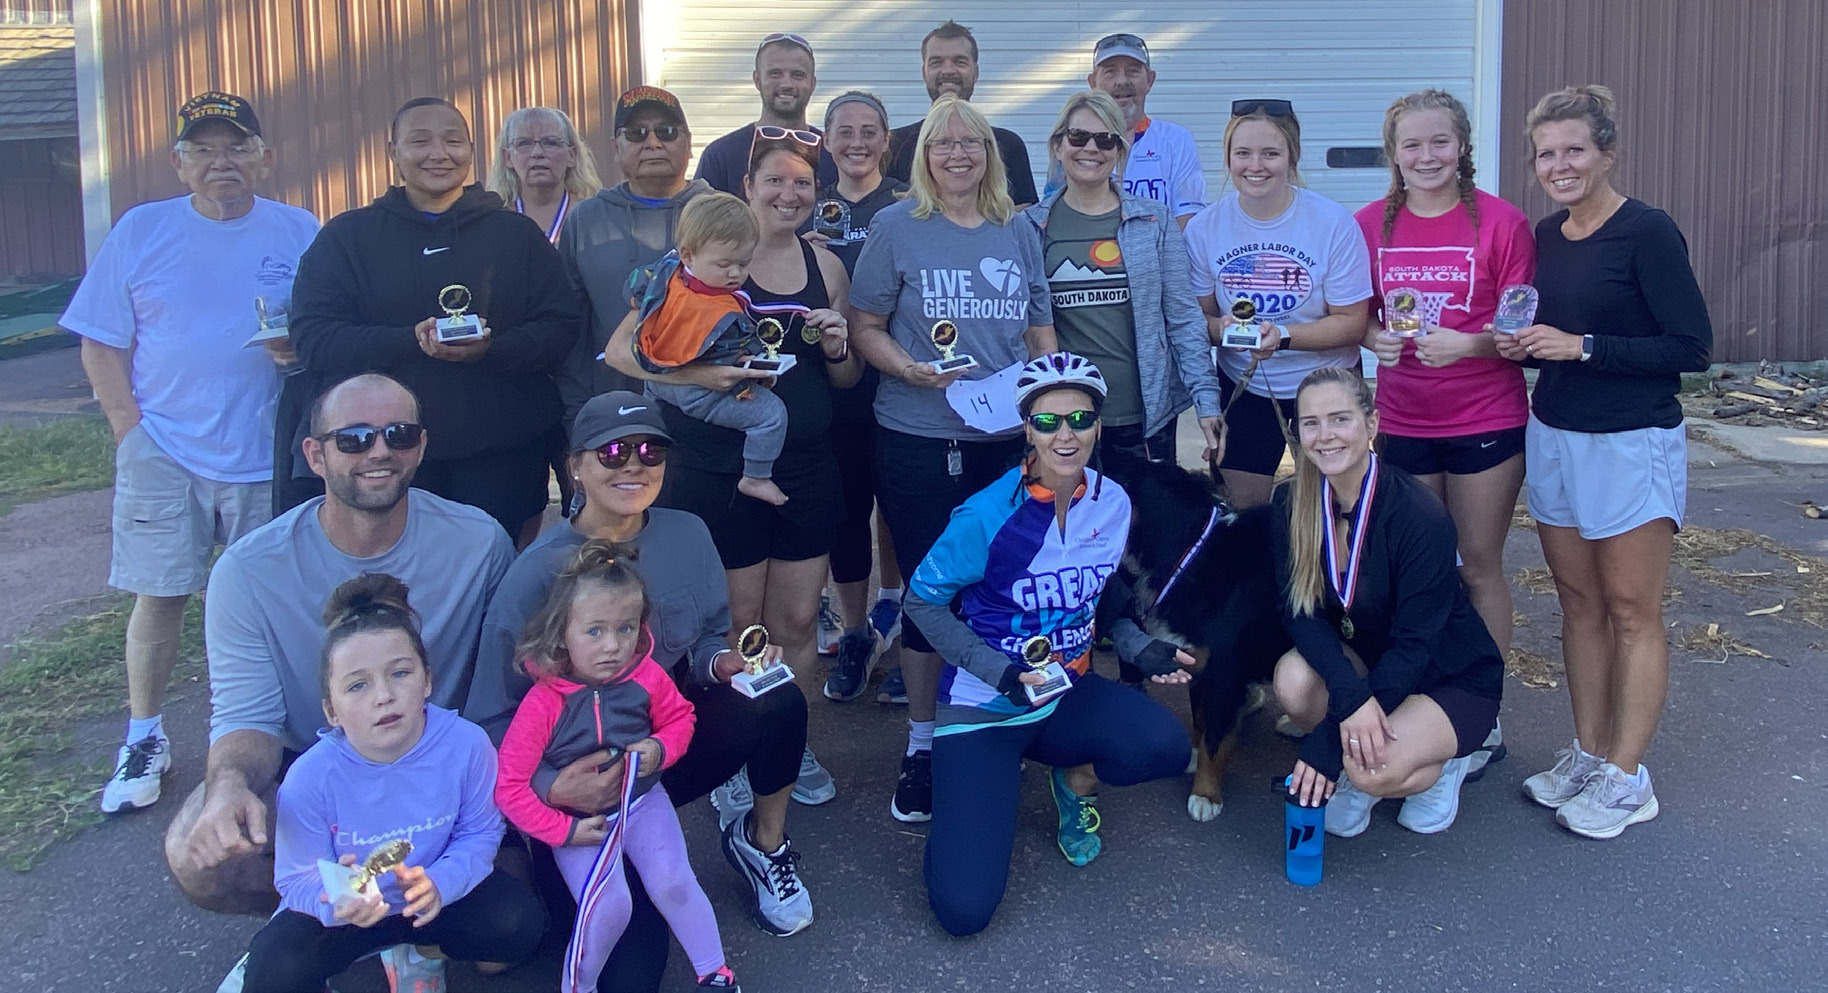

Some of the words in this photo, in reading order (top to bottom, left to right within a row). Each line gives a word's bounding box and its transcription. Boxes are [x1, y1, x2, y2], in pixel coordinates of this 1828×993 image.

[189, 108, 237, 120] VETERAN
[1216, 243, 1259, 266] WAGNER
[1261, 242, 1296, 256] LABOR
[1296, 251, 1316, 268] DAY
[920, 269, 974, 298] LIVE
[1383, 271, 1468, 282] ATTACK
[1052, 292, 1085, 306] SOUTH
[1087, 289, 1128, 302] DAKOTA
[923, 298, 1028, 320] GENEROUSLY
[970, 392, 993, 414] 14
